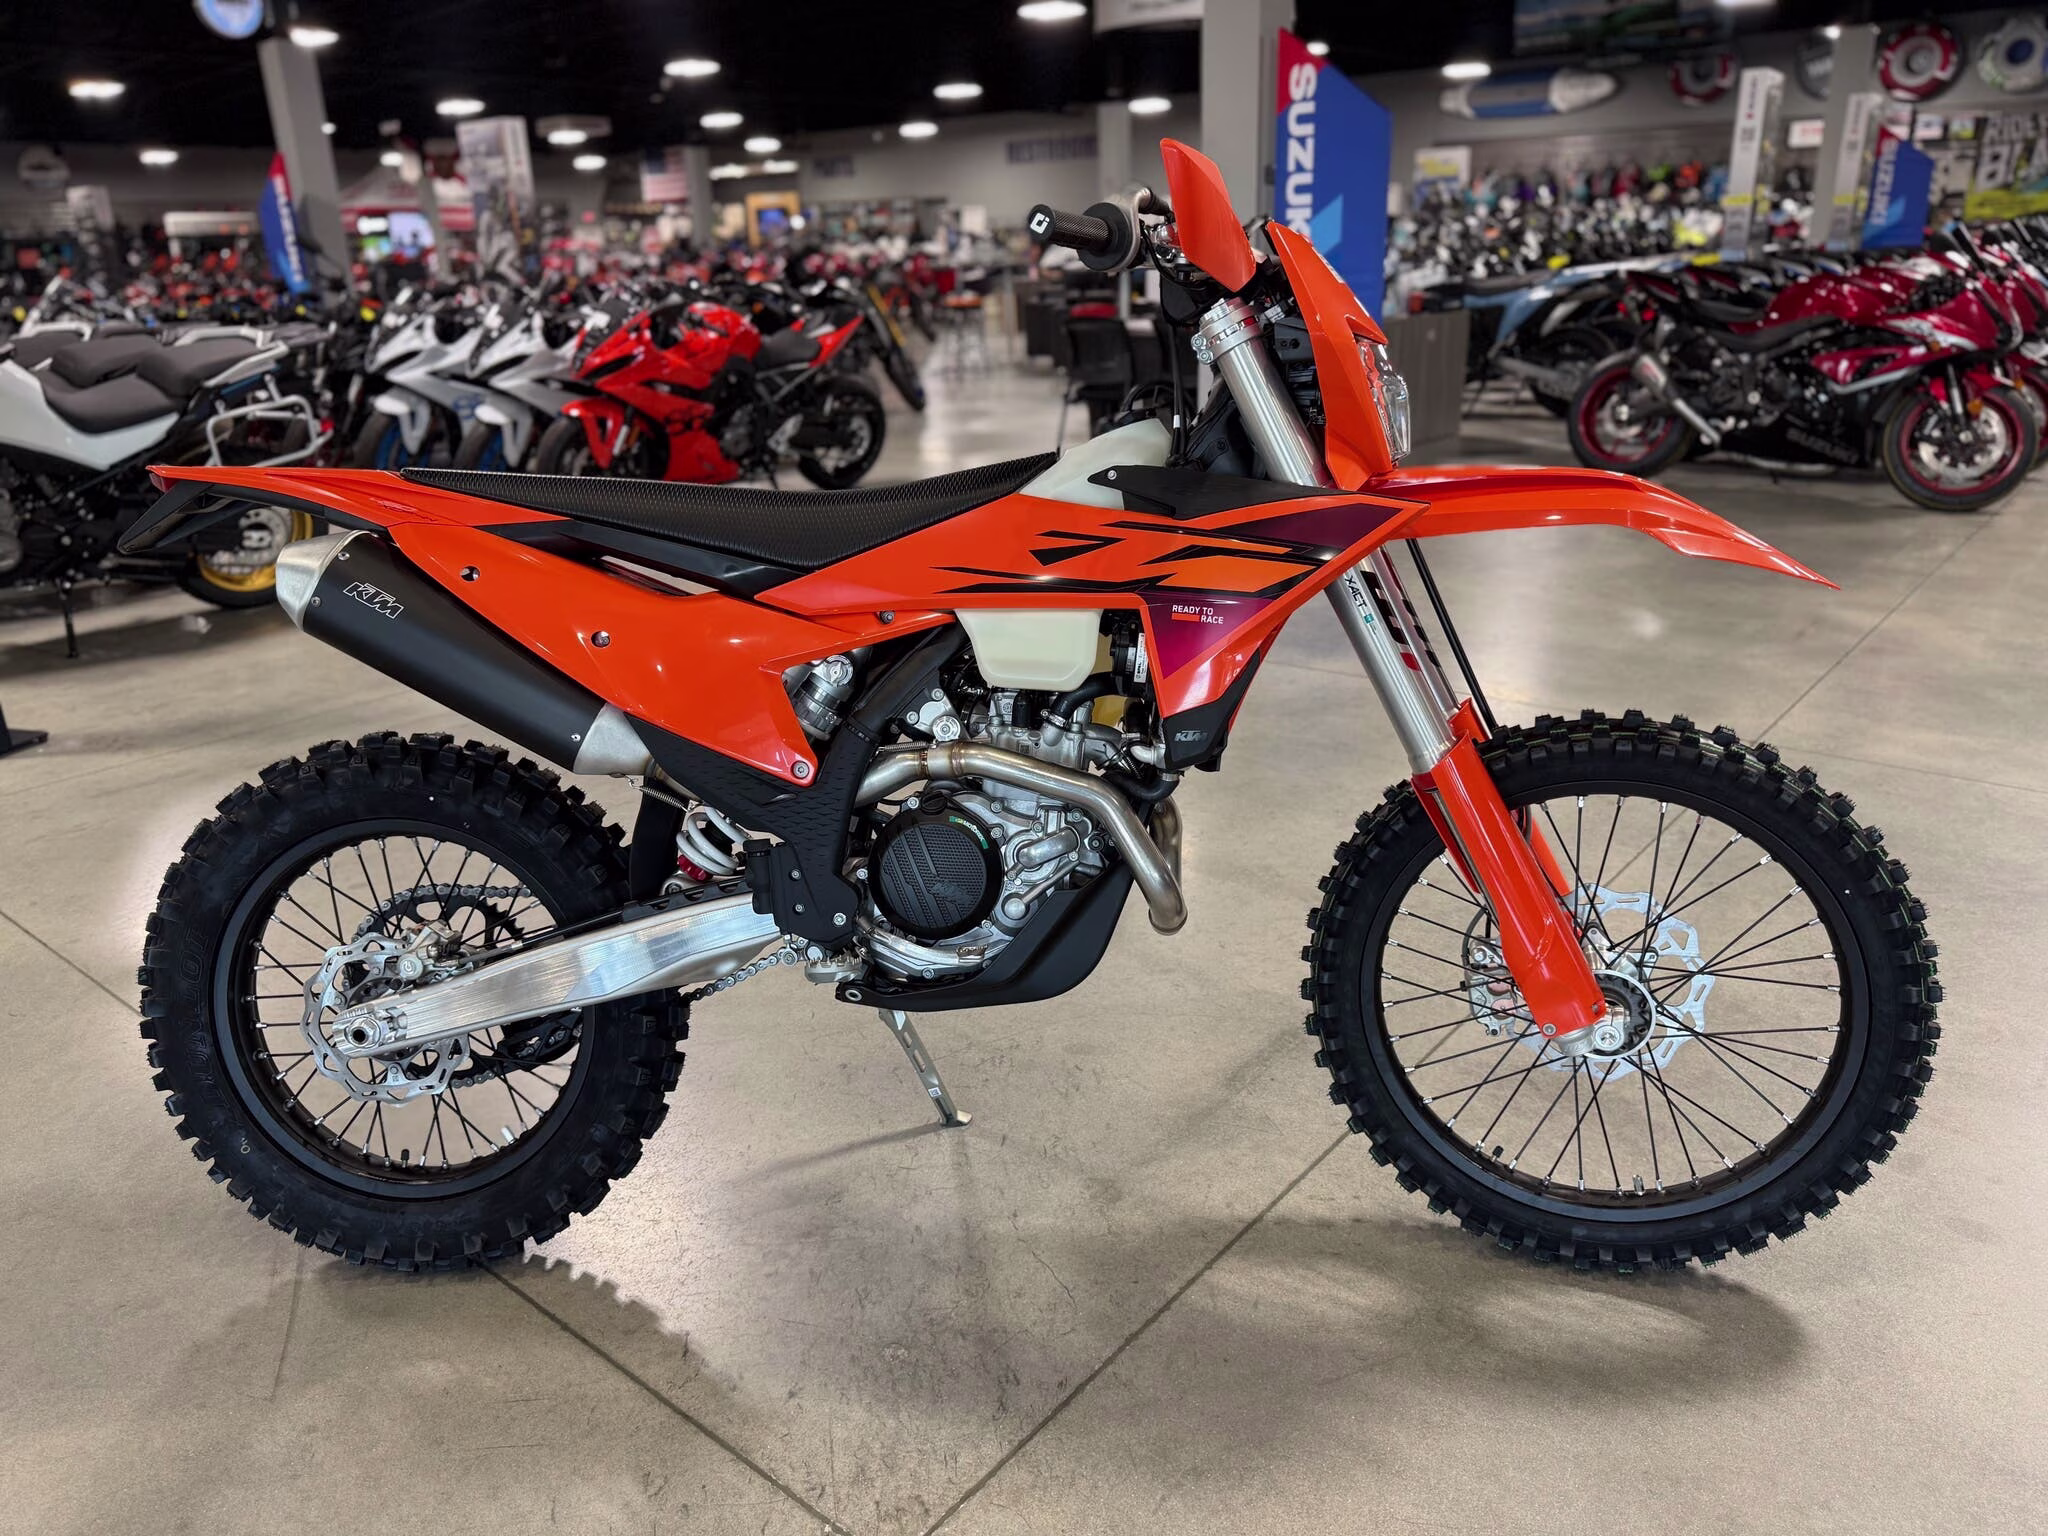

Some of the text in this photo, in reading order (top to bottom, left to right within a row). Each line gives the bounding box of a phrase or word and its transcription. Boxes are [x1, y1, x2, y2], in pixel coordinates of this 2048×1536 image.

[1285, 62, 1318, 243] SUZUK
[1870, 138, 1898, 225] SUZUKI
[343, 581, 404, 619] KTM
[1345, 575, 1368, 608] XACT
[1172, 604, 1213, 615] READY TO
[1201, 615, 1224, 625] RACE
[1174, 730, 1208, 742] KTM
